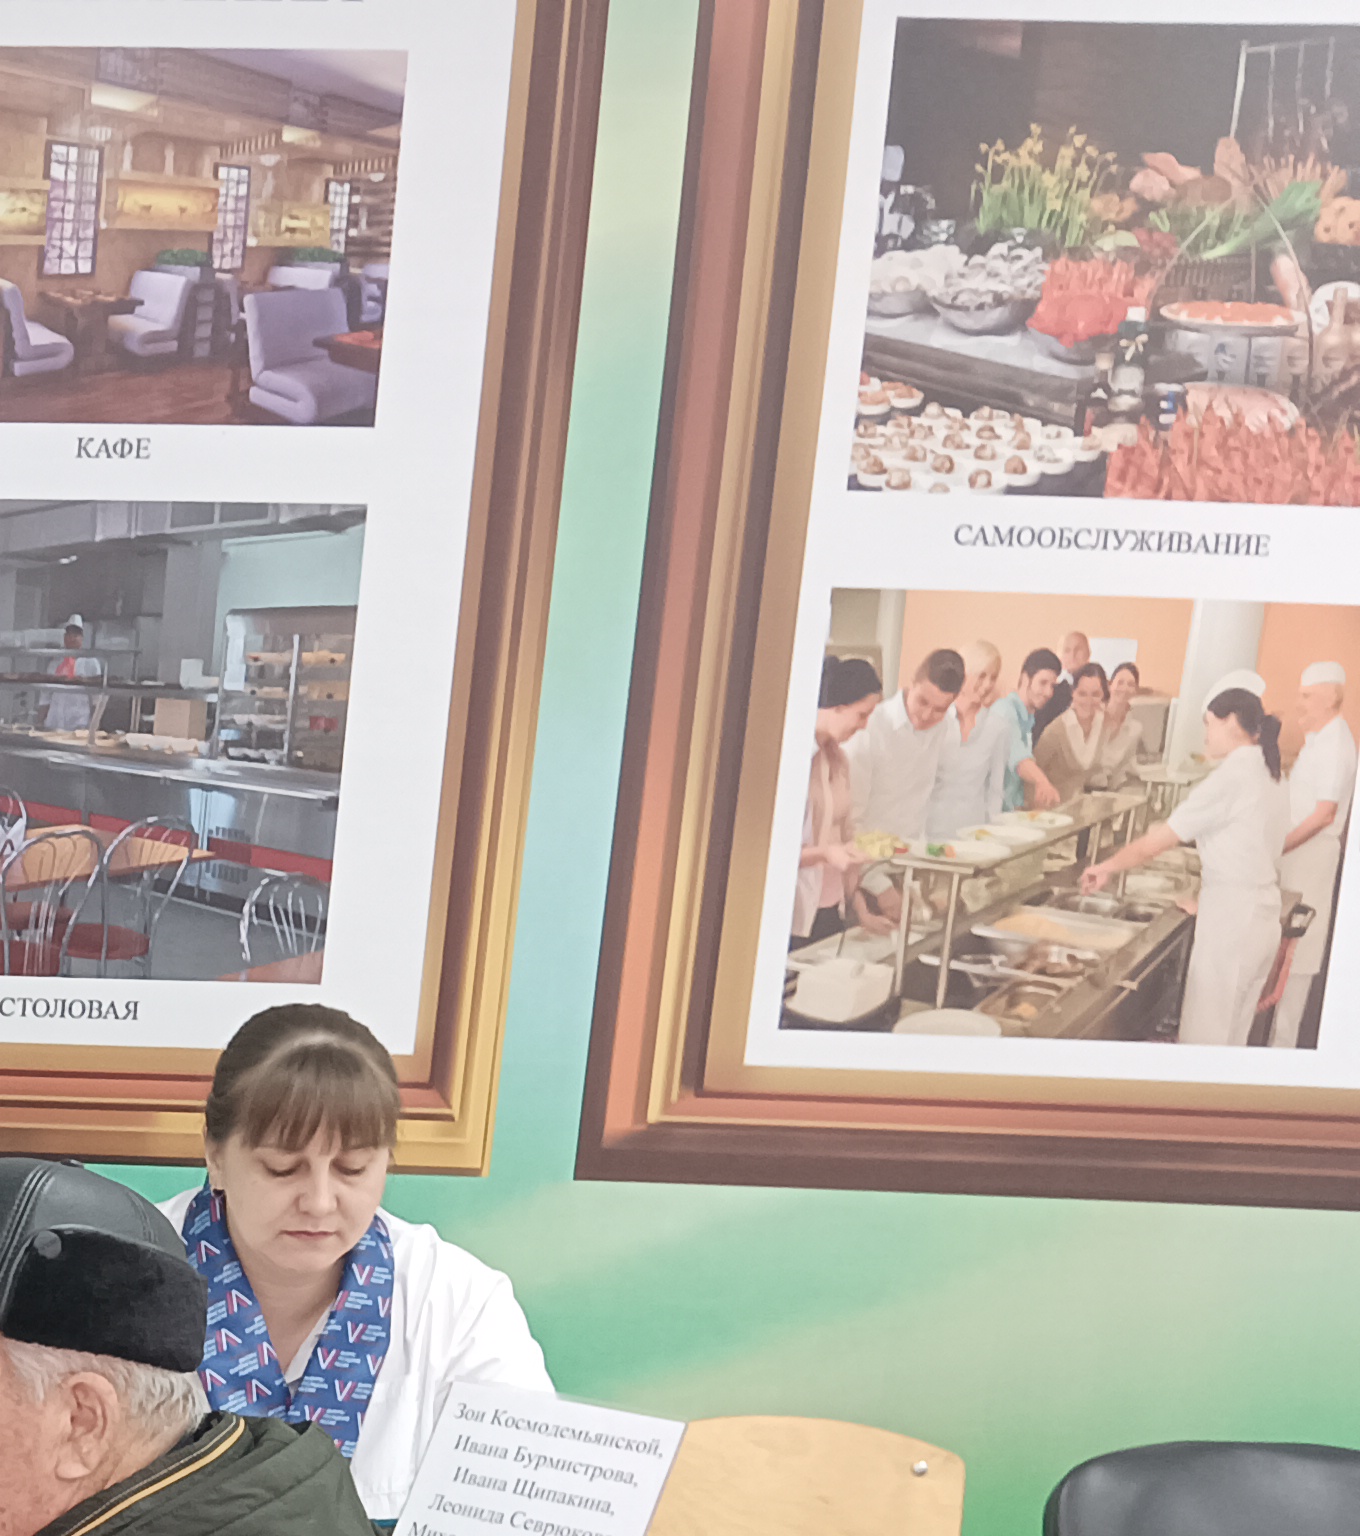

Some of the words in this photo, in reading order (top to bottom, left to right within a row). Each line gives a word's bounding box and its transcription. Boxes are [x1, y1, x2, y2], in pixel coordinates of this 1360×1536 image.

[76, 437, 151, 459] КАФЕ
[953, 524, 1271, 556] САМООБСЛУЖИВАНИЕ
[454, 1402, 485, 1424] Зои
[491, 1408, 663, 1458] Космодемьянской,
[454, 1434, 508, 1460] Ивана
[513, 1446, 638, 1488] Бурмистрова,
[427, 1493, 505, 1525] Леонида
[452, 1466, 508, 1492] Ивана
[513, 1477, 615, 1517] Щипакина,
